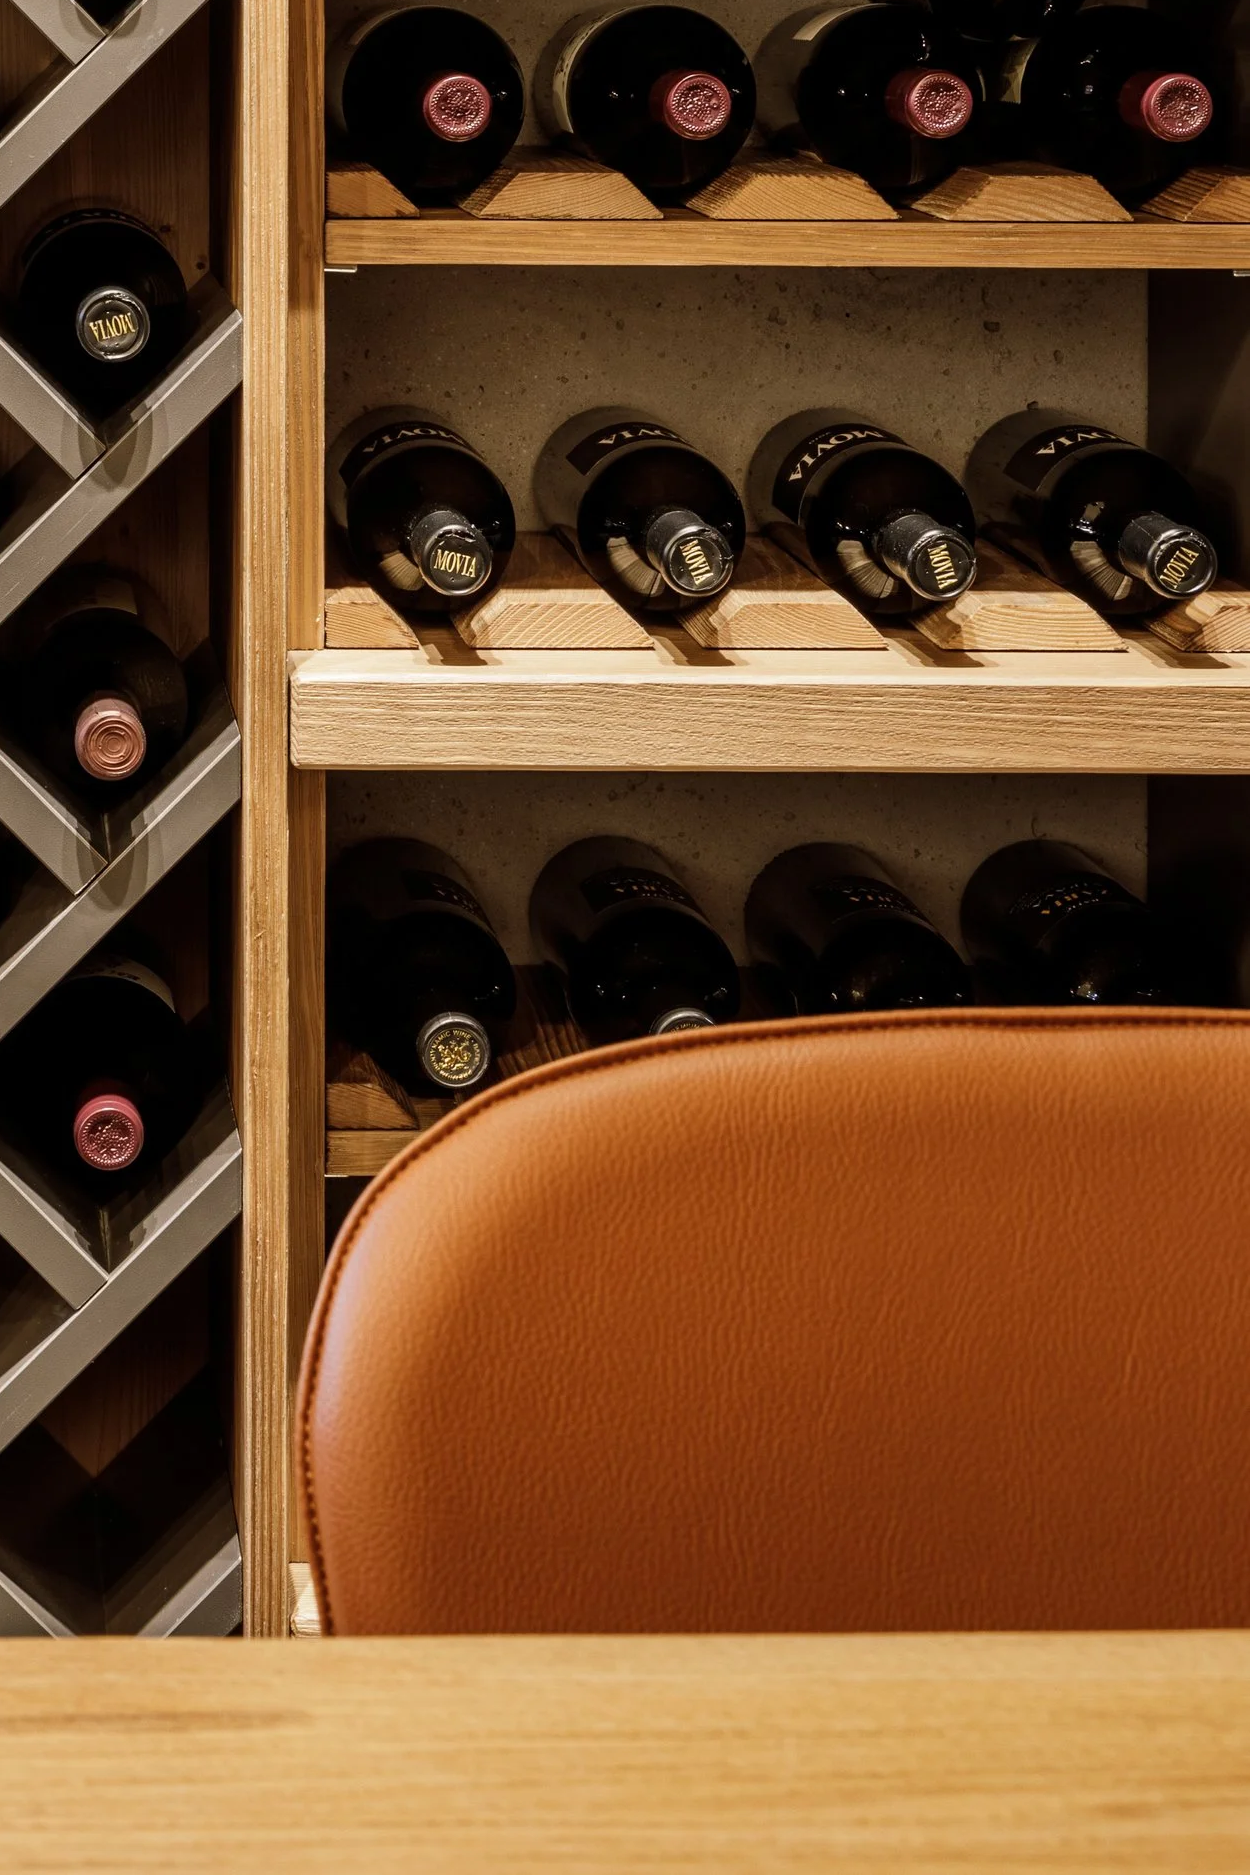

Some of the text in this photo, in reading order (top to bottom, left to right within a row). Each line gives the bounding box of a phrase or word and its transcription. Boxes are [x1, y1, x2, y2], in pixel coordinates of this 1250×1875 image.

[89, 312, 136, 342] MOVIA
[788, 430, 885, 482] MOVIA
[434, 549, 476, 578] MOVIA
[679, 539, 714, 586] MOVIA
[927, 543, 958, 590] MOVIA
[1159, 546, 1200, 590] MOVIA
